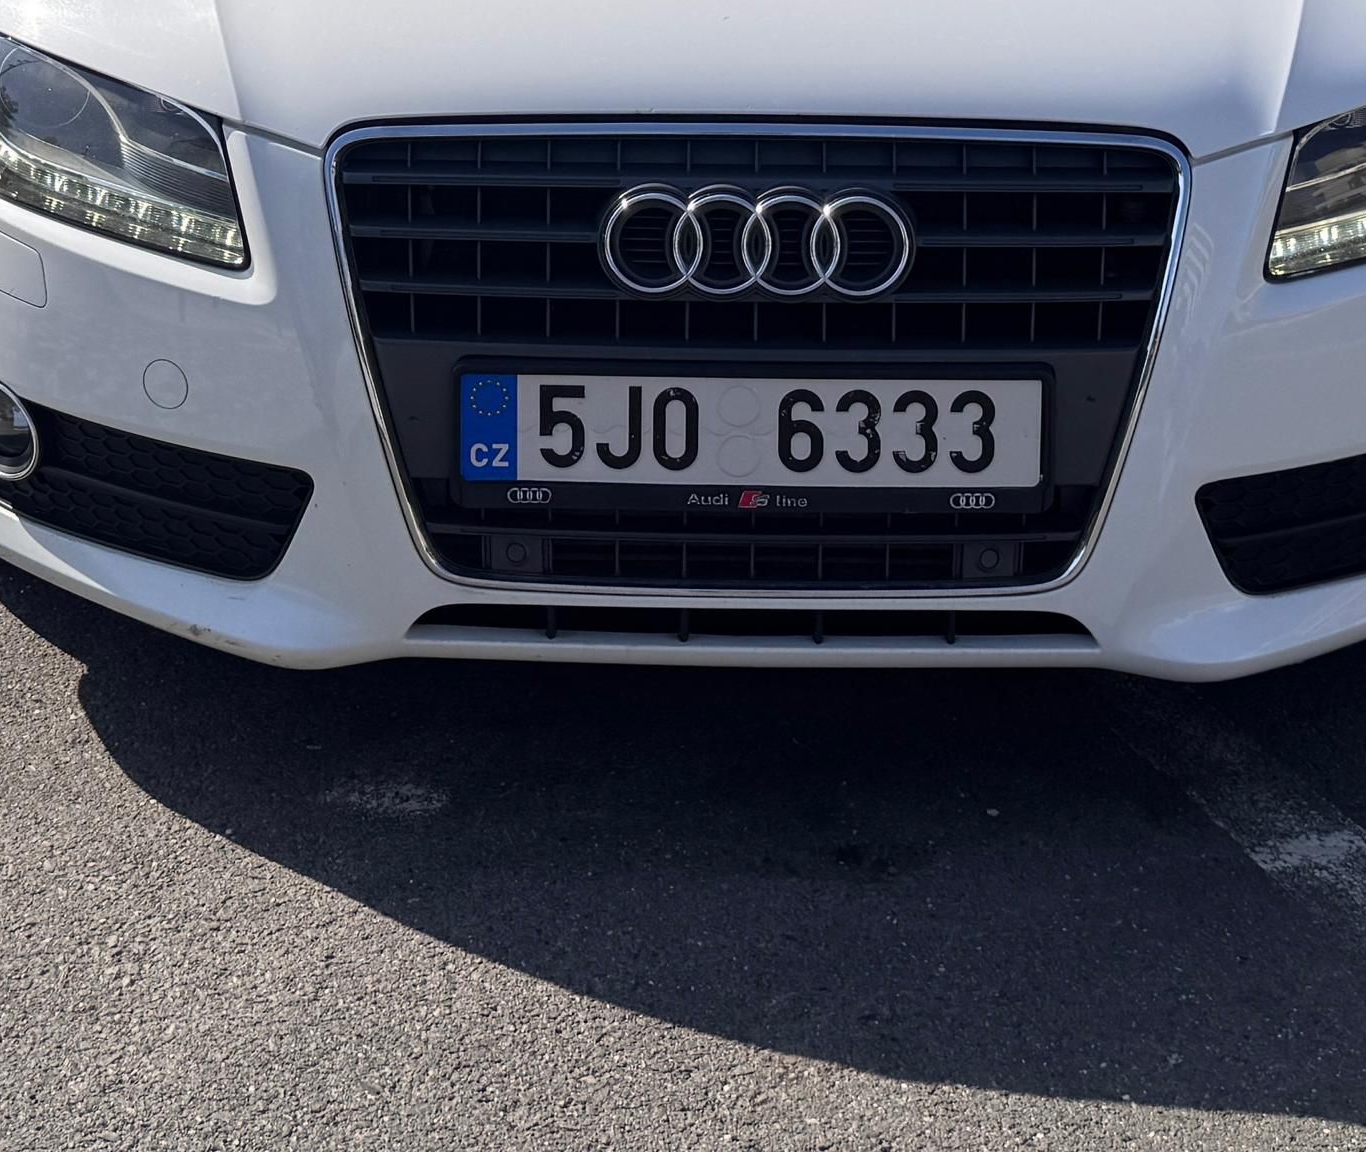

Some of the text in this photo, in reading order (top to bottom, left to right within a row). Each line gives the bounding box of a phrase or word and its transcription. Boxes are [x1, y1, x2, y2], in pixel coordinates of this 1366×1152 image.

[538, 383, 996, 474] 5J0 6333
[469, 443, 510, 468] CZ
[687, 493, 729, 505] Audi
[776, 494, 808, 507] line
